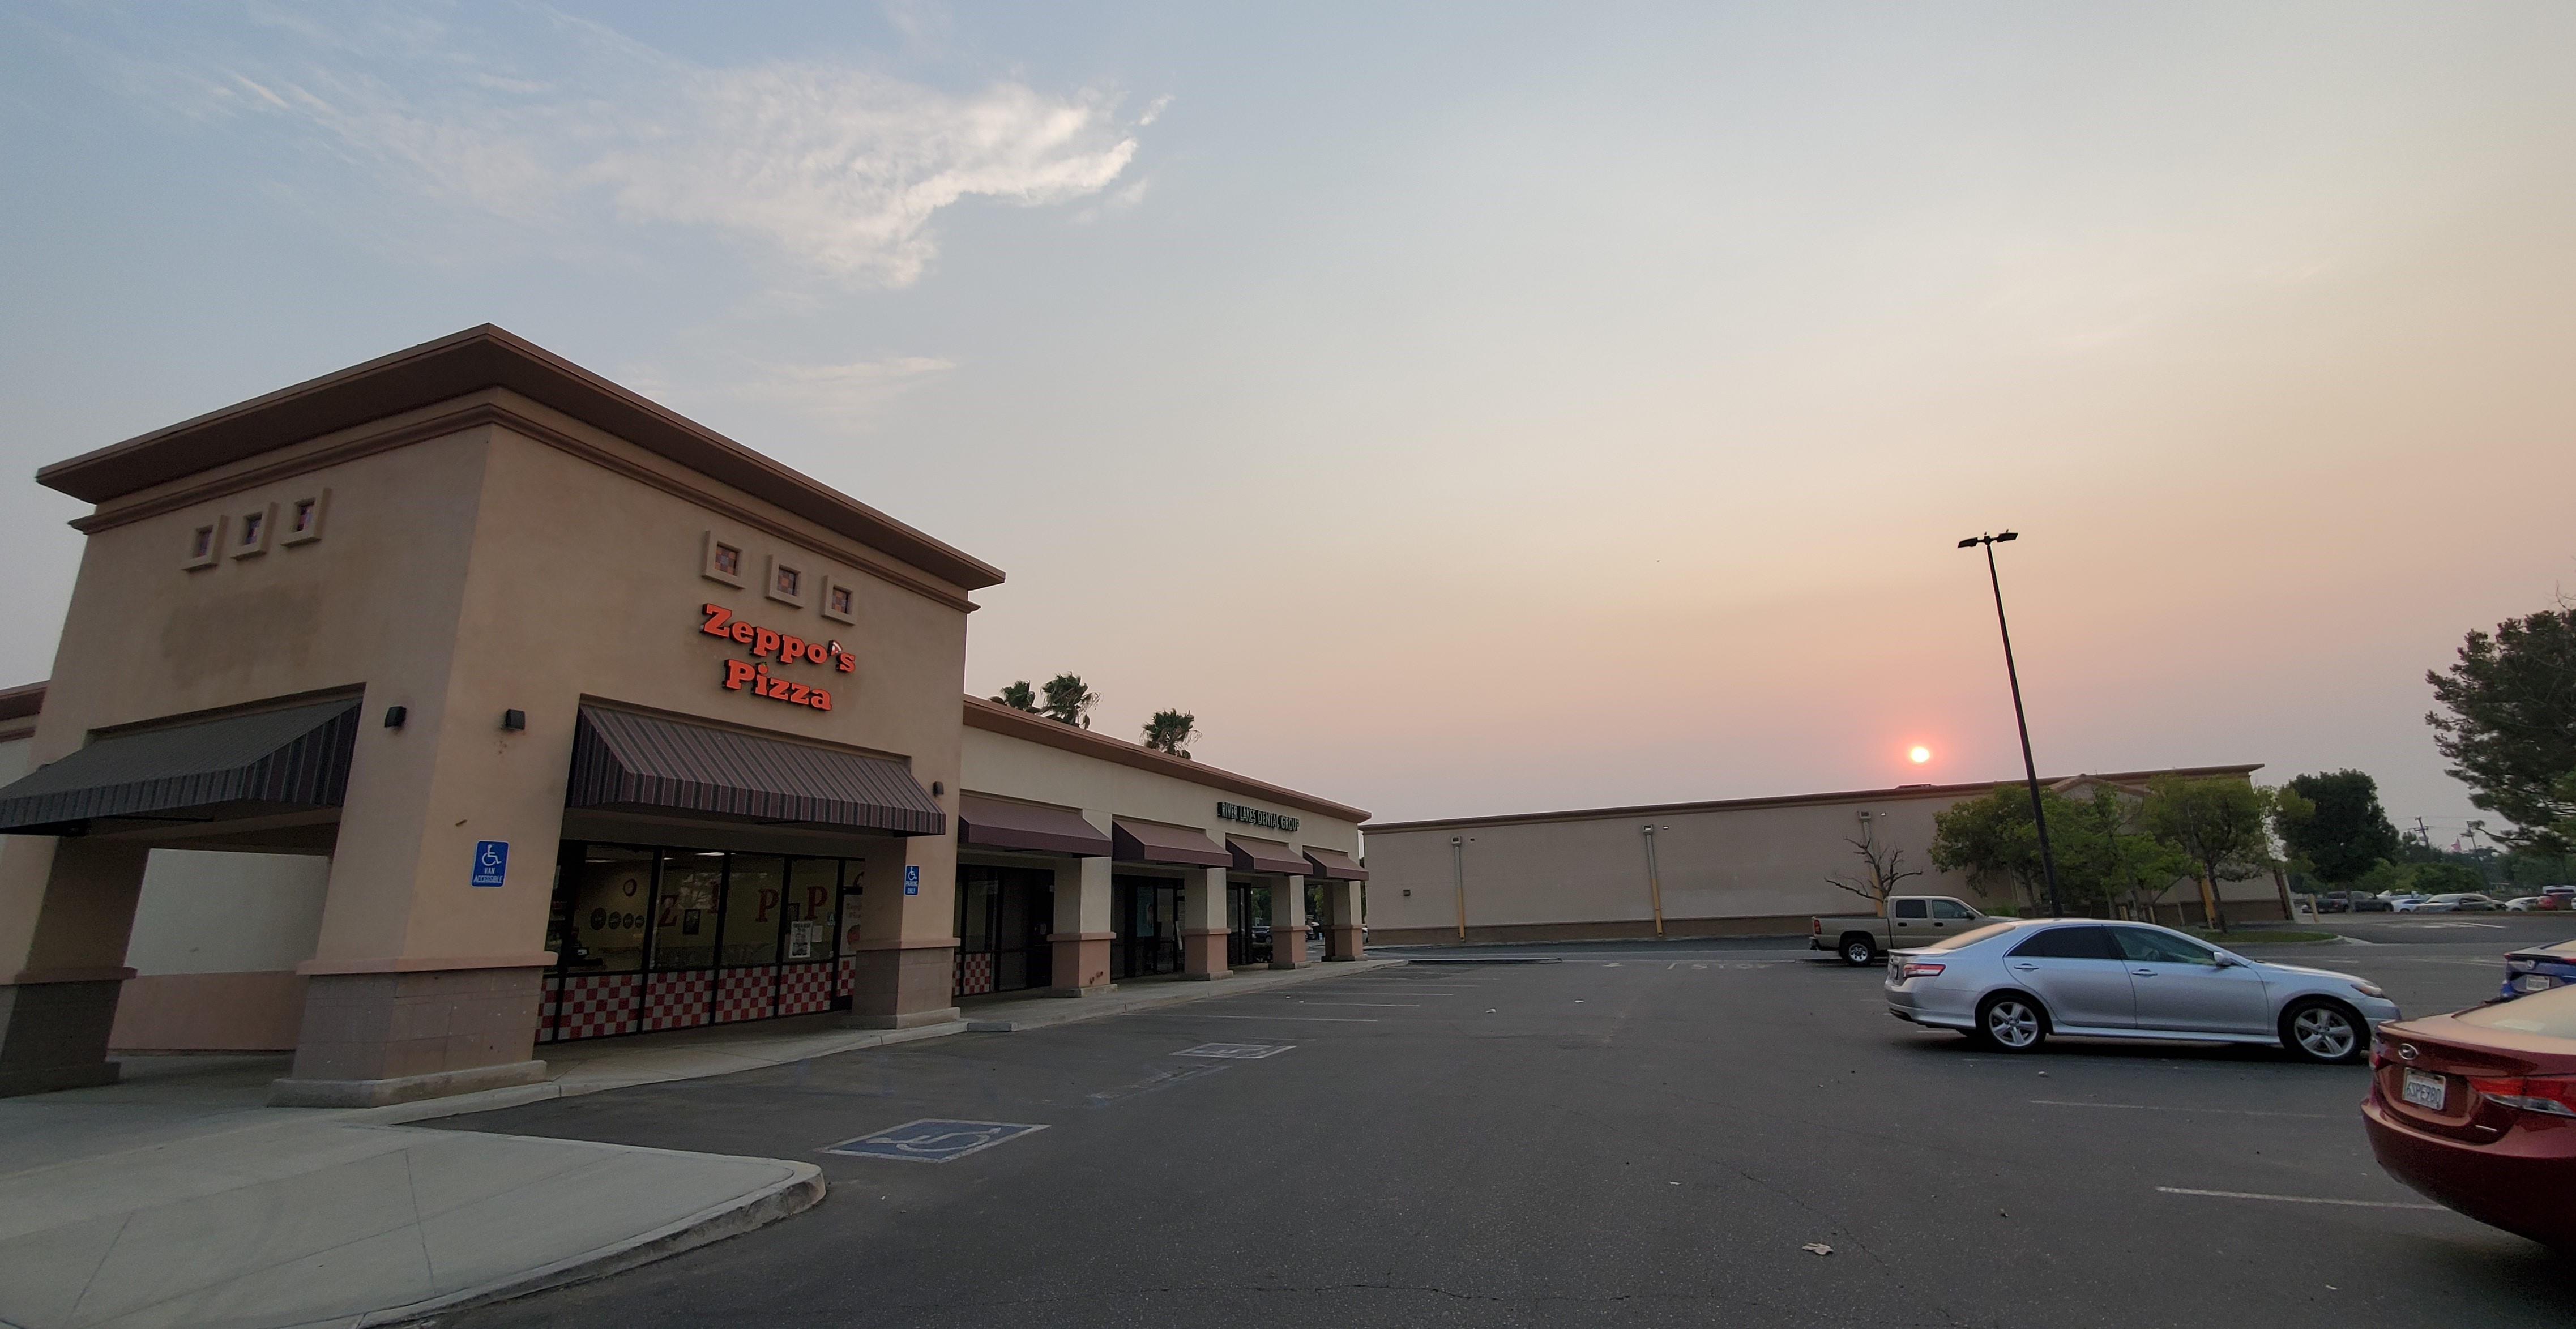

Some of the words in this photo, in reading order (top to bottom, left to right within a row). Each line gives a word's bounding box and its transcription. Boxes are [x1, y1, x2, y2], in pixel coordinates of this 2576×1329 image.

[700, 603, 855, 673] Zeppo's
[723, 659, 831, 710] Pizza
[1221, 802, 1238, 820] RIVER
[1240, 806, 1257, 824] LAKES
[1258, 810, 1280, 829] DENTAL
[1281, 815, 1300, 832] GROUP
[473, 875, 503, 883] ACCESSIBLE
